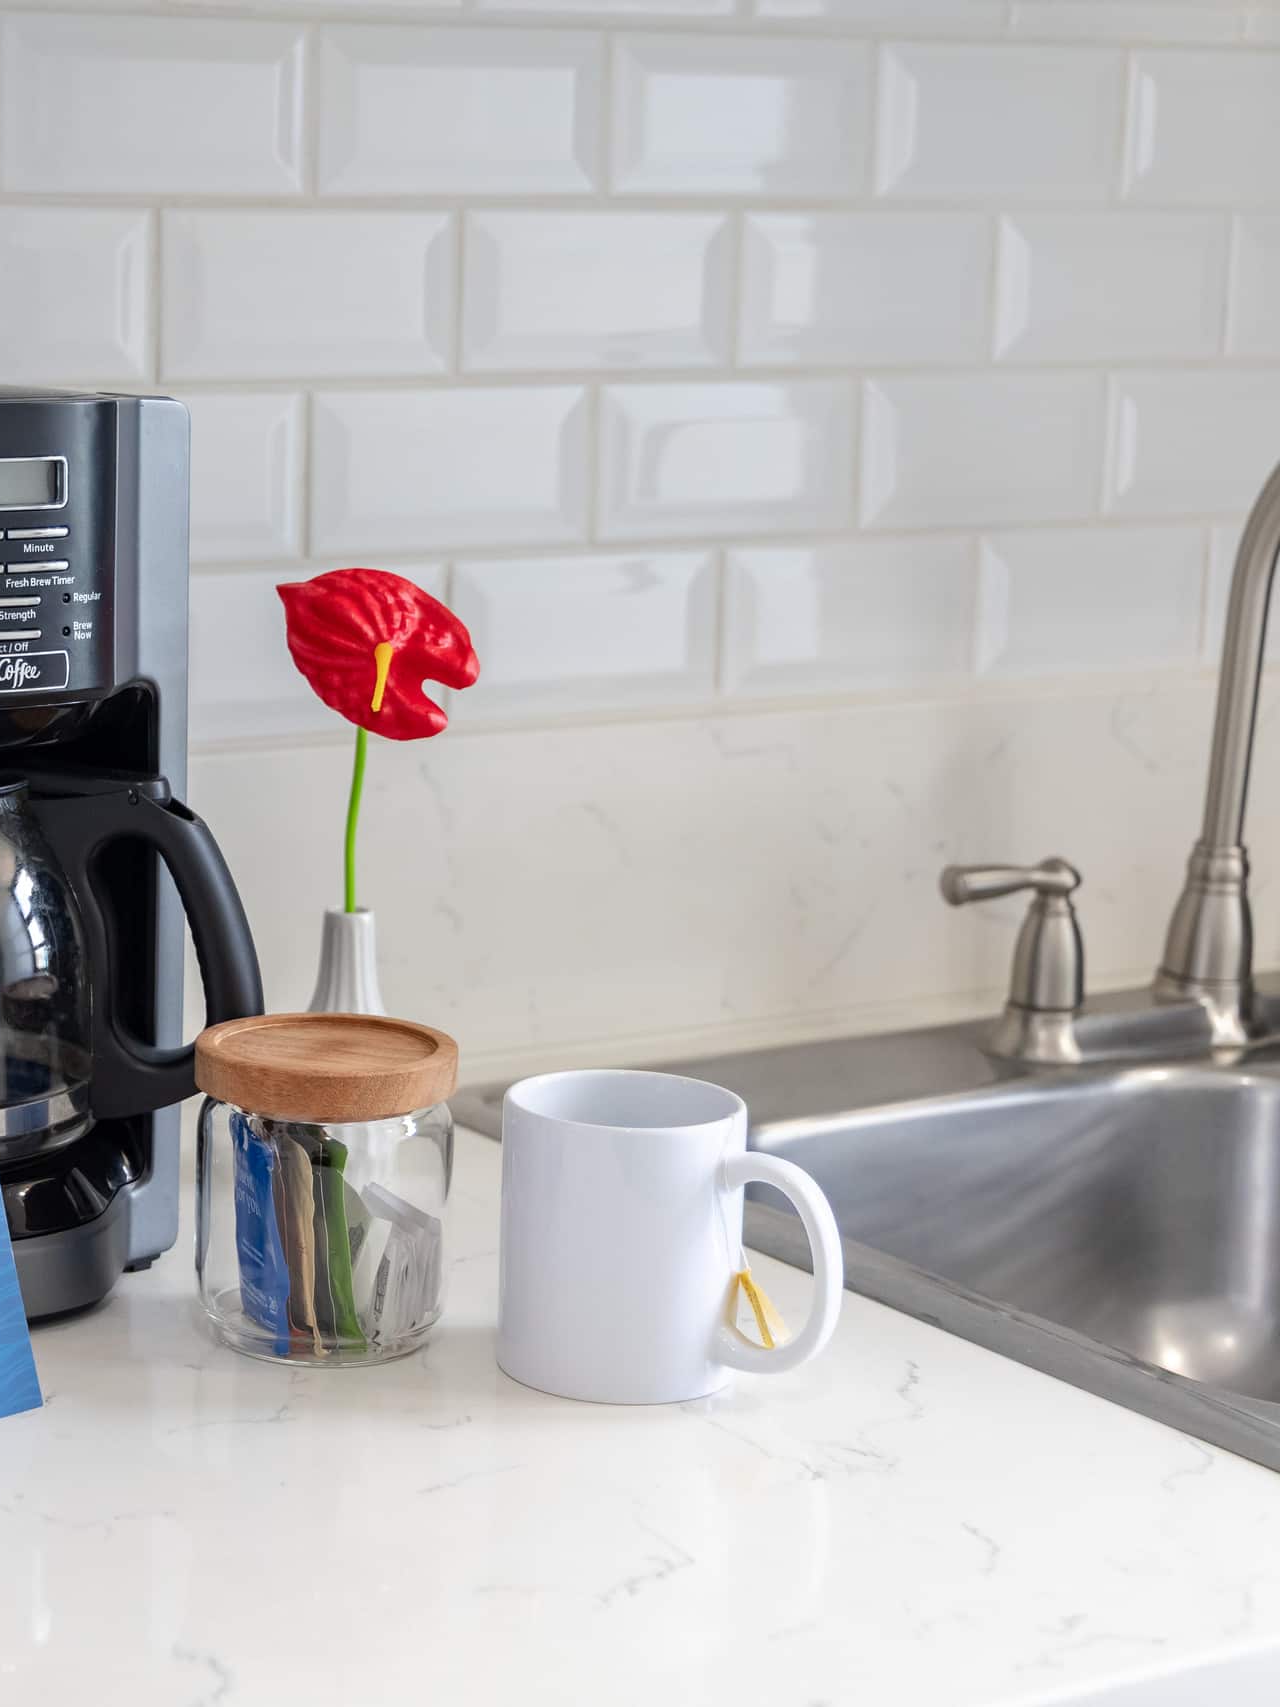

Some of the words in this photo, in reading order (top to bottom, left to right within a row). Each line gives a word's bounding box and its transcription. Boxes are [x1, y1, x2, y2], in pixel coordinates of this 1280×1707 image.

[23, 543, 55, 553] Minute
[5, 577, 29, 588] Fresh
[30, 577, 51, 586] Brew
[52, 575, 75, 585] Timer
[73, 592, 101, 603] Regular
[73, 621, 93, 630] Brew
[74, 631, 92, 640] Now
[14, 641, 29, 652] Off
